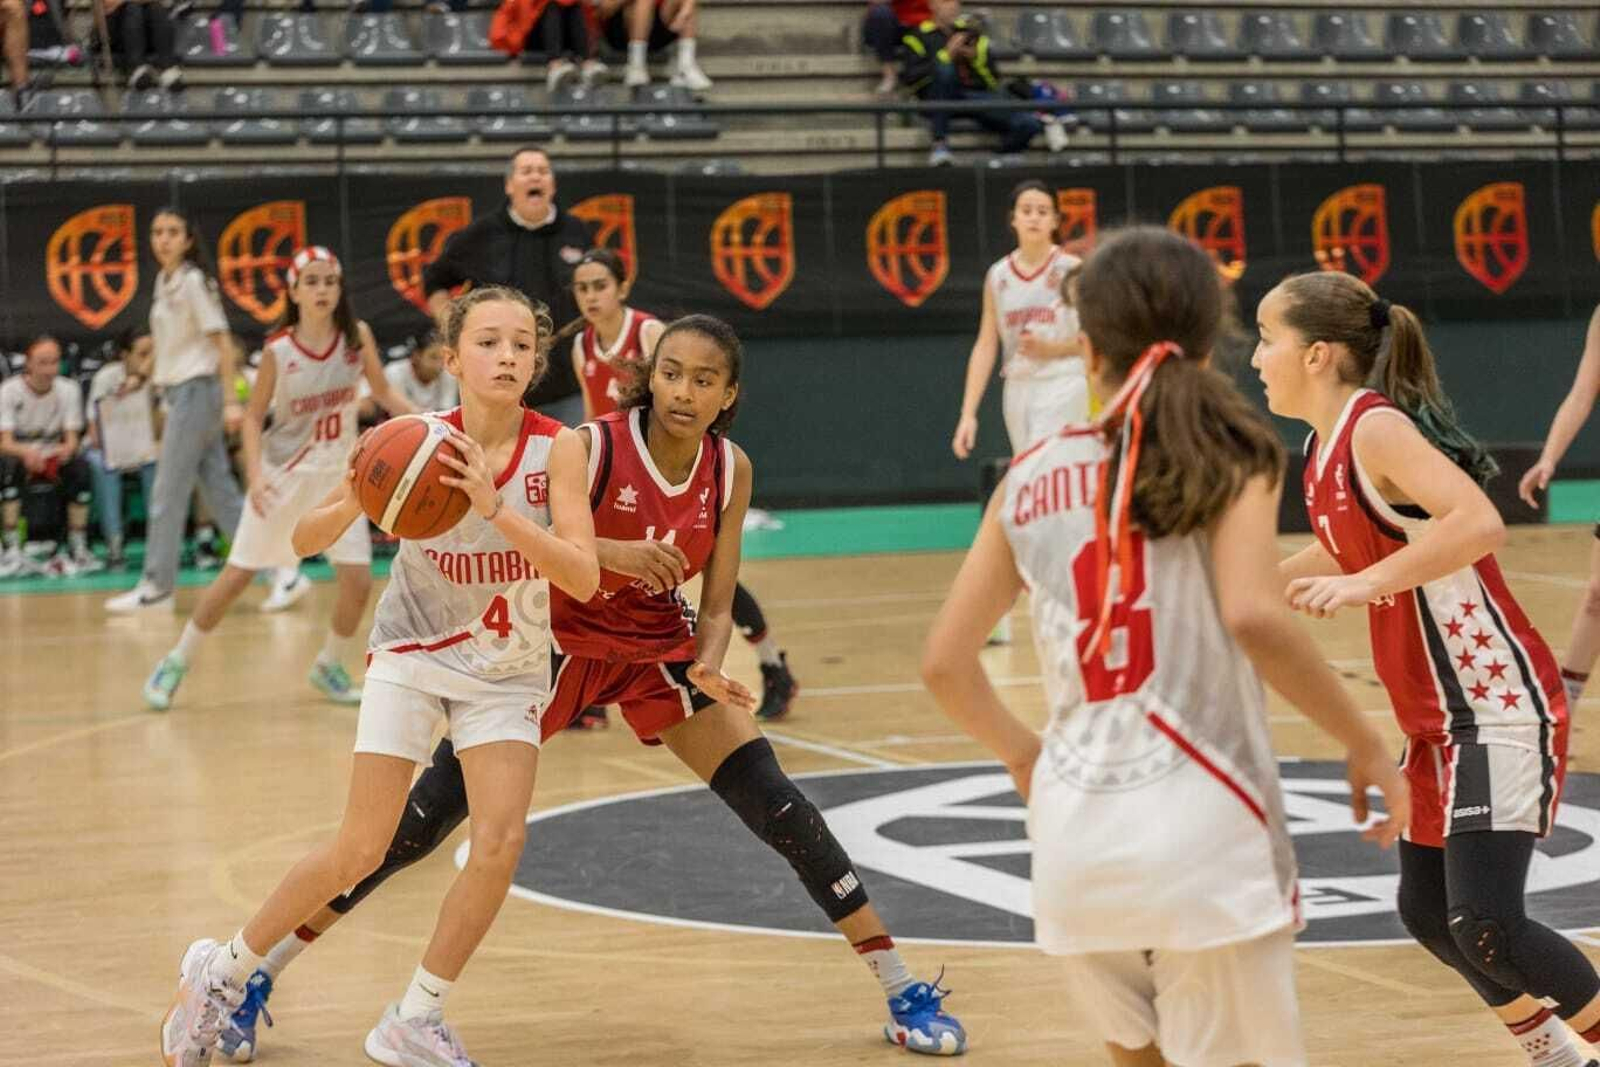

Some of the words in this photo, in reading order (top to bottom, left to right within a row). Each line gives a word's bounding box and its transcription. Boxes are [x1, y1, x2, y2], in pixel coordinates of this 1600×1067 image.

[315, 411, 341, 442] 10
[1014, 463, 1094, 527] CANT
[1317, 514, 1340, 555] 7
[481, 594, 513, 638] 4
[1071, 530, 1155, 703] 8
[839, 870, 859, 895] NBA
